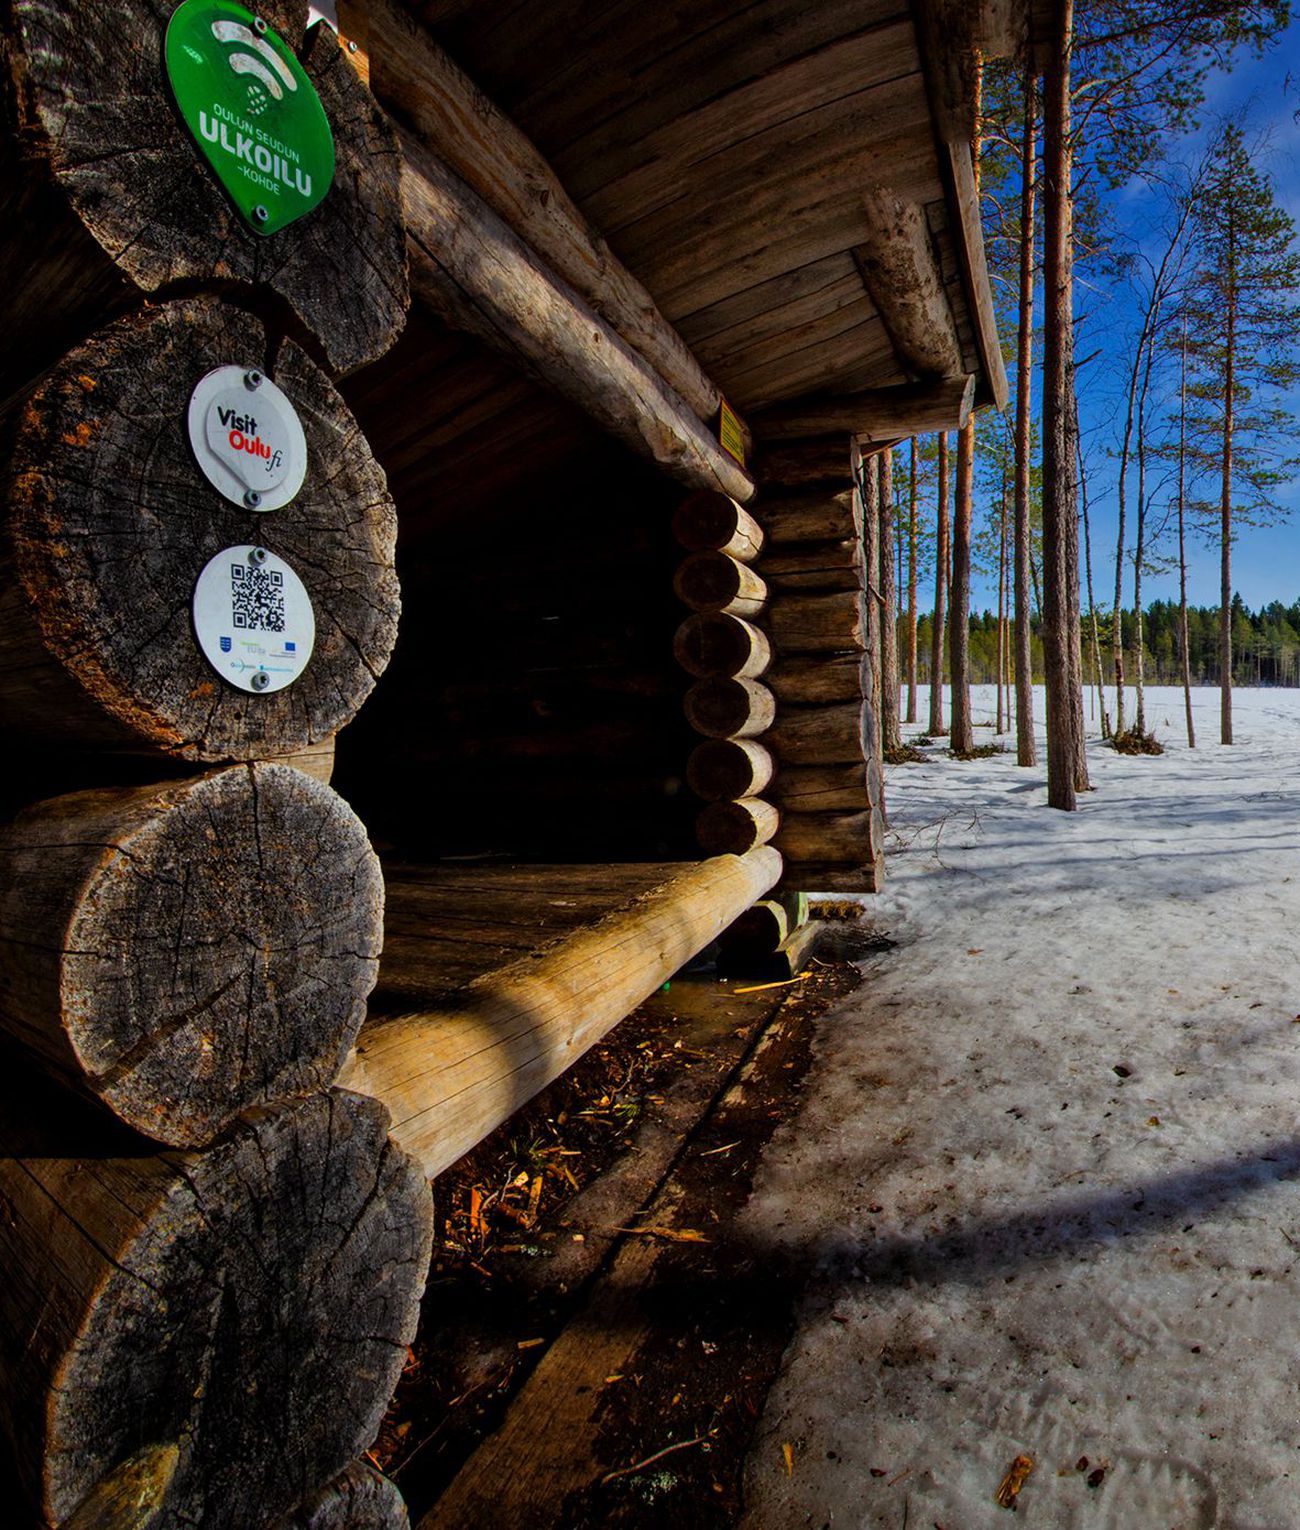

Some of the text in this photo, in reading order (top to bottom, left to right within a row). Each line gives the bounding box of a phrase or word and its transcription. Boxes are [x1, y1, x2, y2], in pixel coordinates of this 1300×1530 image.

[199, 110, 312, 197] ULKOILU
[213, 103, 299, 163] OULUN SEUDUN
[217, 406, 258, 436] Visit
